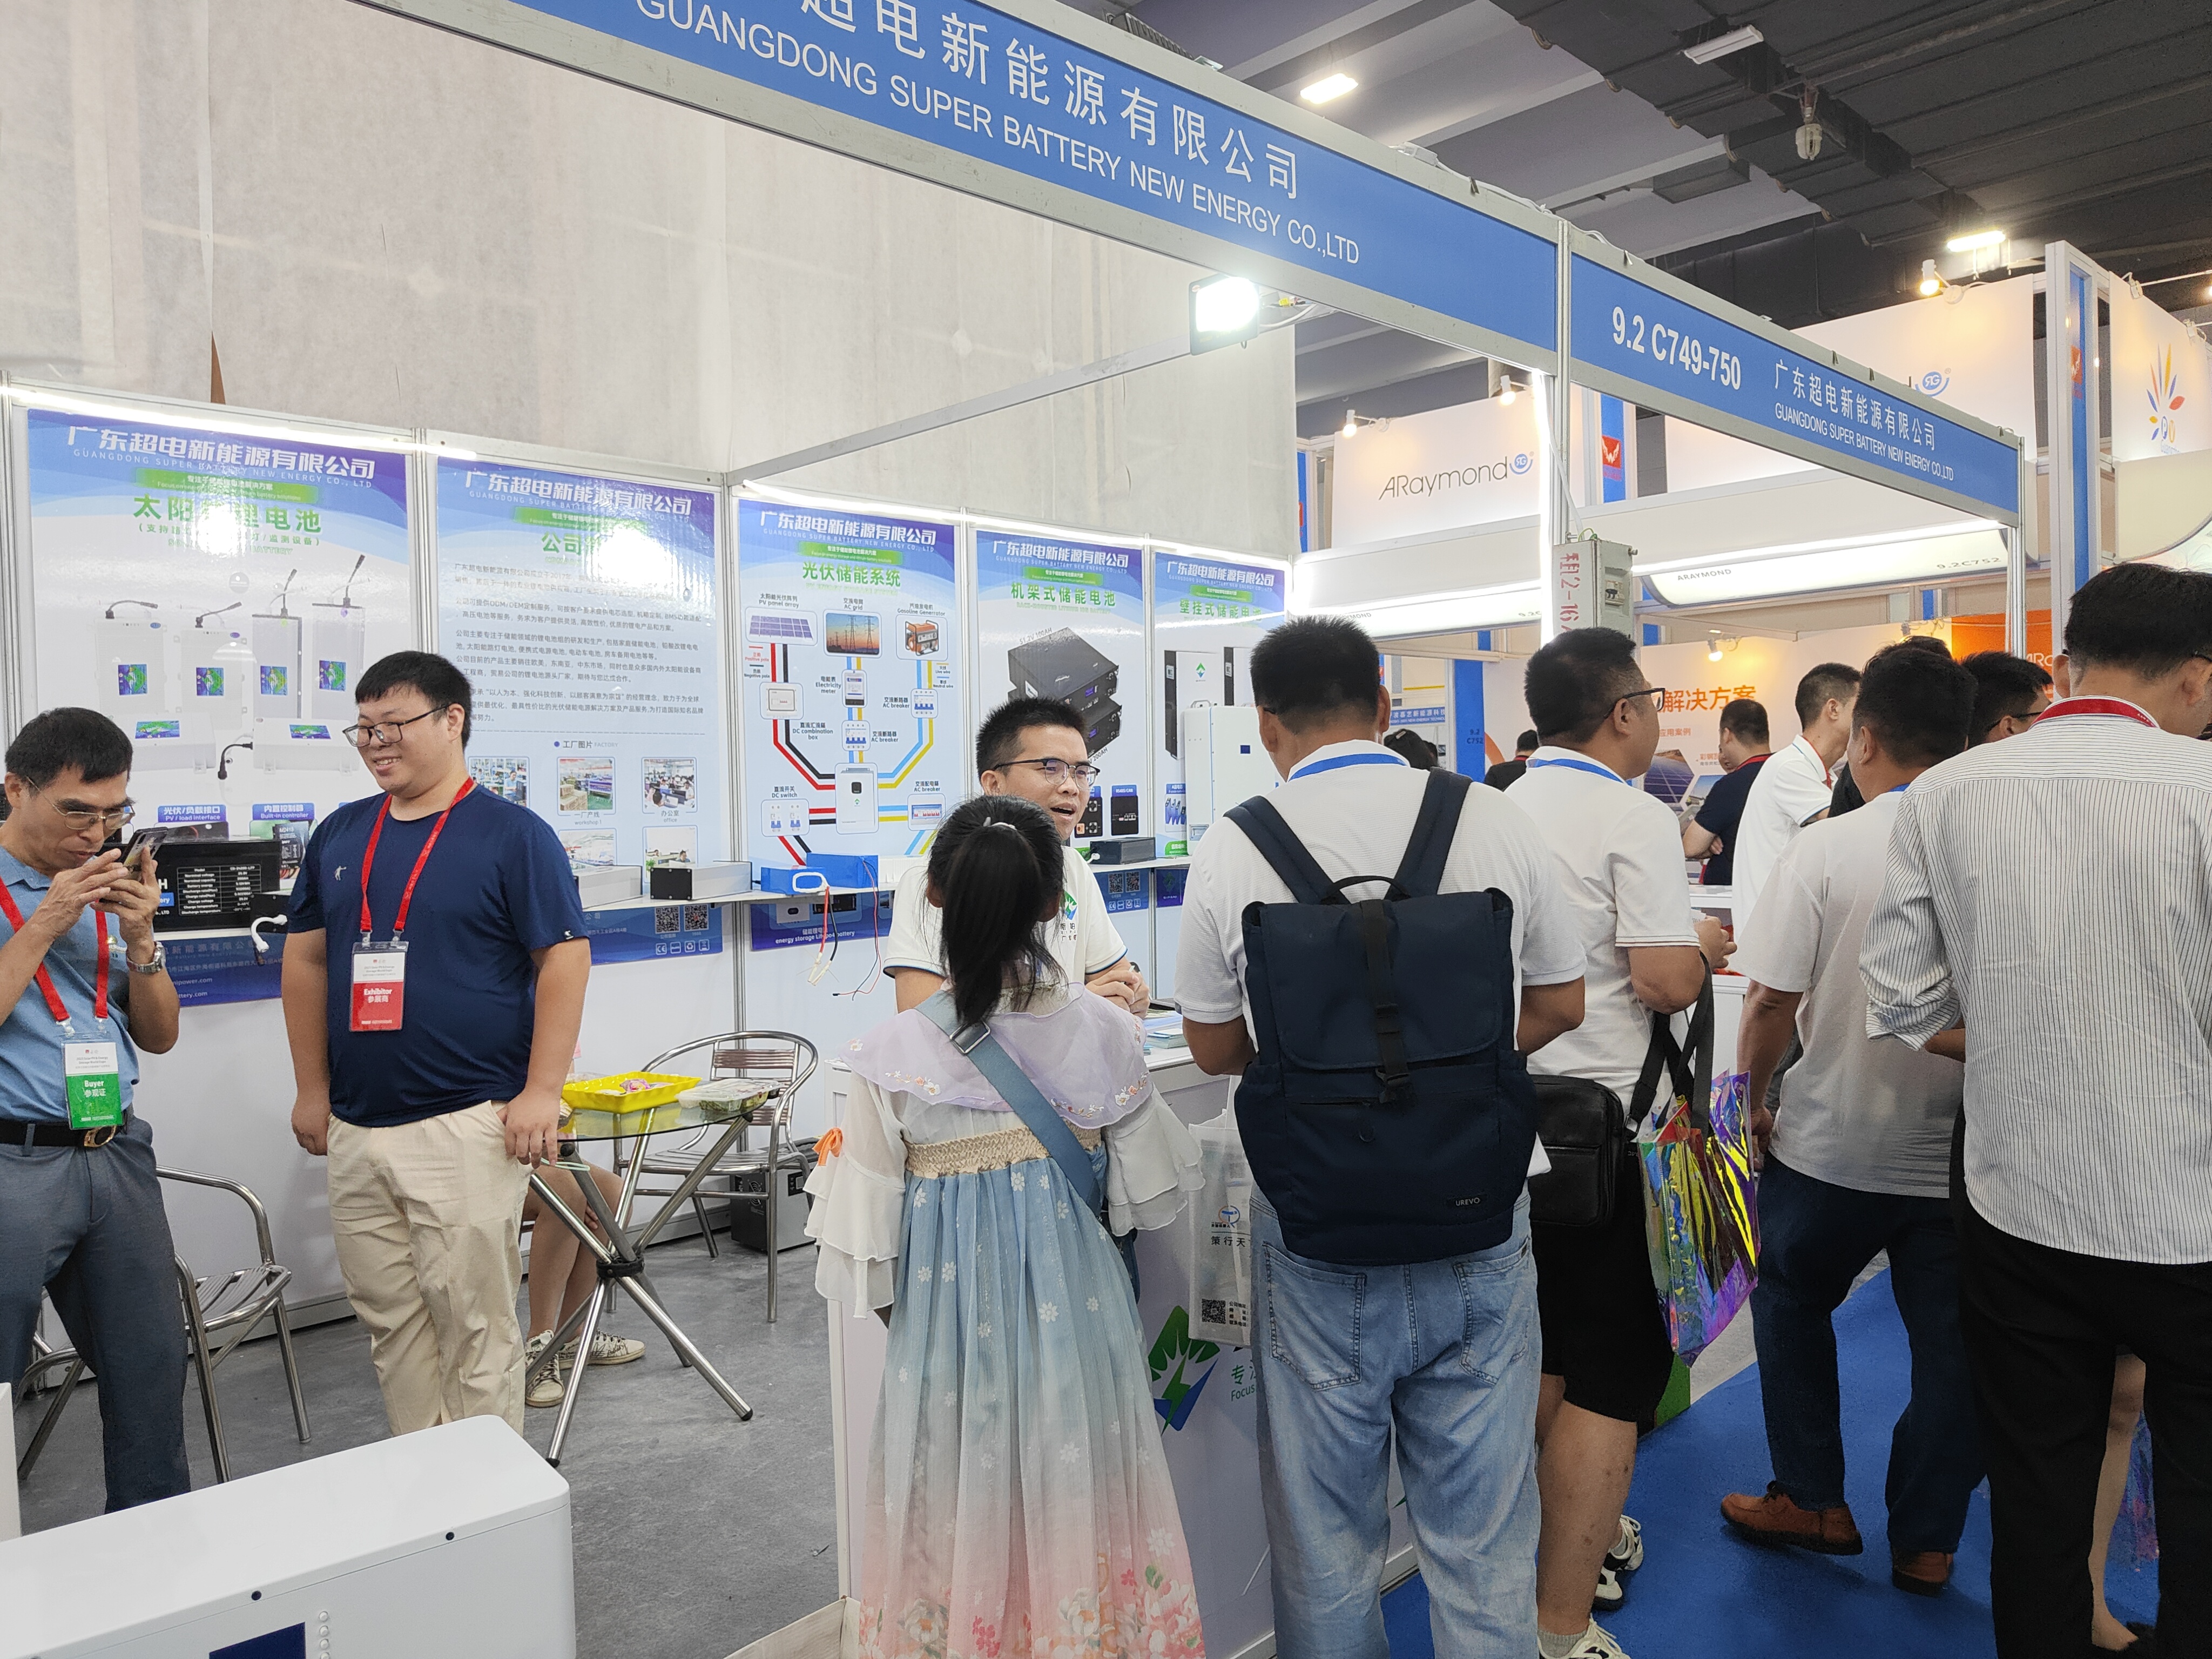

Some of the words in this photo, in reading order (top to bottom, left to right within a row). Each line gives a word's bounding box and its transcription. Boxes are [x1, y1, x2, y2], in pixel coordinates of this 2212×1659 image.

[637, 0, 878, 95] GUANGDONG
[890, 75, 993, 138] SUPER
[1004, 115, 1122, 180] BATTERY
[1130, 164, 1184, 204] NEW
[1193, 184, 1280, 238] ENERGY
[1288, 219, 1360, 264] CO.,LTD
[1613, 306, 1645, 354] 9.2
[1651, 323, 1742, 390] C749-750
[1775, 359, 1935, 450] 广东超电新能源有限公司
[68, 426, 375, 480] 广东超电新能源有限公司
[1775, 402, 1827, 436] GUANGDONG
[1830, 423, 1854, 446] SUPER
[1857, 433, 1886, 457] BATTERY
[1888, 444, 1904, 463] NEW
[1905, 451, 1931, 473] ENERGY
[1932, 461, 1954, 481] CO.,LTD
[74, 449, 150, 464] GUANGDONG
[156, 459, 193, 469] SUPER
[253, 469, 275, 477] NEW
[281, 472, 322, 483] ENERGY
[354, 480, 372, 488] LTD
[1378, 456, 1508, 500] ARaymond
[465, 471, 692, 516] 广东超电新能源有限公司
[469, 490, 525, 503] GUANGDONG
[528, 498, 557, 508] SUPER
[133, 493, 321, 533] 太阳锂电池
[760, 510, 936, 545] 广东超电新能源有限公司
[764, 529, 806, 538] GUANGDONG
[834, 537, 862, 545] BATTERY
[993, 541, 1129, 568] 广东超电新能源有限公司
[995, 556, 1029, 564] GUANGDONG
[1937, 557, 2002, 570] 9.2C752
[802, 561, 901, 588] 光伏储能系统
[1167, 561, 1274, 587] 广东超电新能源有限公司
[1677, 569, 1732, 581] ARAYMOND
[1011, 582, 1115, 607] 机架式储能电池
[1035, 628, 1052, 638] 100AH
[563, 740, 593, 749] 工厂图片
[1093, 747, 1108, 761] 200AH
[837, 930, 855, 939] battery
[84, 1080, 104, 1088] Buyer
[1455, 1196, 1481, 1206] UREVO
[1211, 1236, 1251, 1247] 策行天
[1231, 1384, 1256, 1402] Focus
